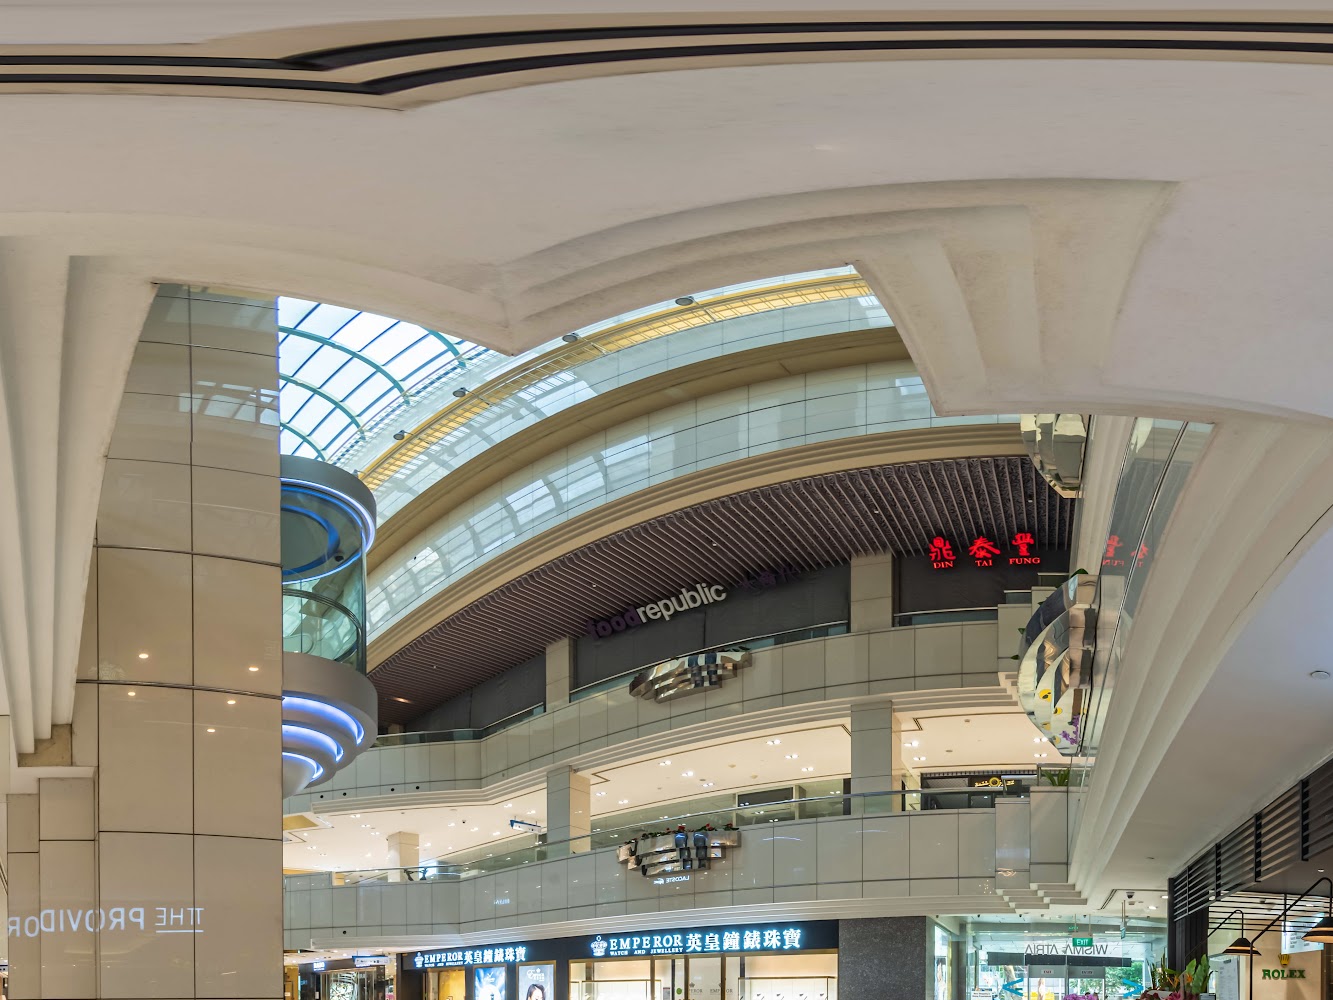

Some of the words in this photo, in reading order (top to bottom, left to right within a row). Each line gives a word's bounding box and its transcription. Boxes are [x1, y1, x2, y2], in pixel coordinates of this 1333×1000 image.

[933, 561, 954, 569] DIN
[975, 559, 993, 567] TAI
[1009, 556, 1040, 565] FUNG
[610, 935, 683, 951] EMPEROR
[424, 951, 463, 963] EMPEROR
[1262, 969, 1305, 979] ROLEX
